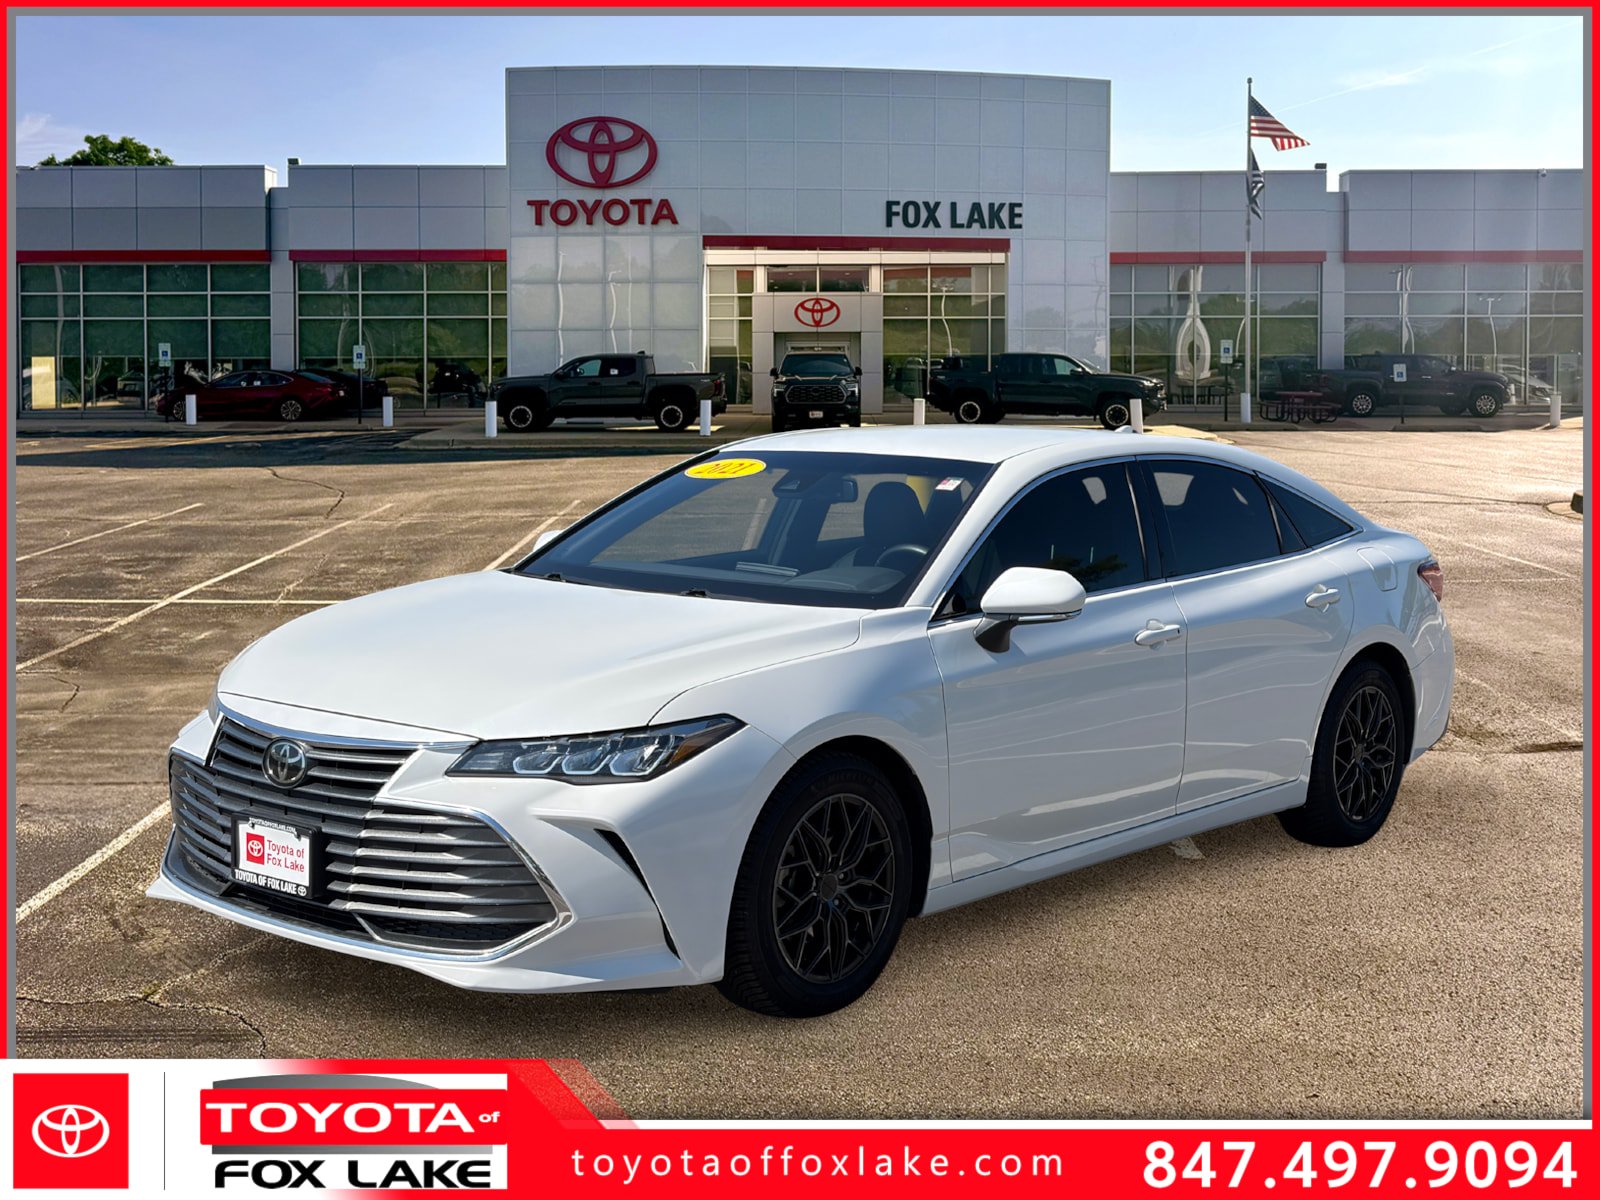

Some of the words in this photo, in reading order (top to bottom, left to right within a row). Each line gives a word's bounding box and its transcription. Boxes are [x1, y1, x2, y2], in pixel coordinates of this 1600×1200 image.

[527, 198, 679, 227] TOYOTA
[885, 200, 942, 229] FOX
[950, 201, 1023, 229] LAKE
[267, 840, 294, 858] Toyota
[296, 848, 305, 859] of
[267, 853, 282, 868] Fox
[284, 857, 305, 873] Lake
[235, 869, 258, 885] TOYOTA
[258, 876, 266, 886] OF
[267, 878, 280, 891] FOX
[281, 881, 297, 894] LAKE
